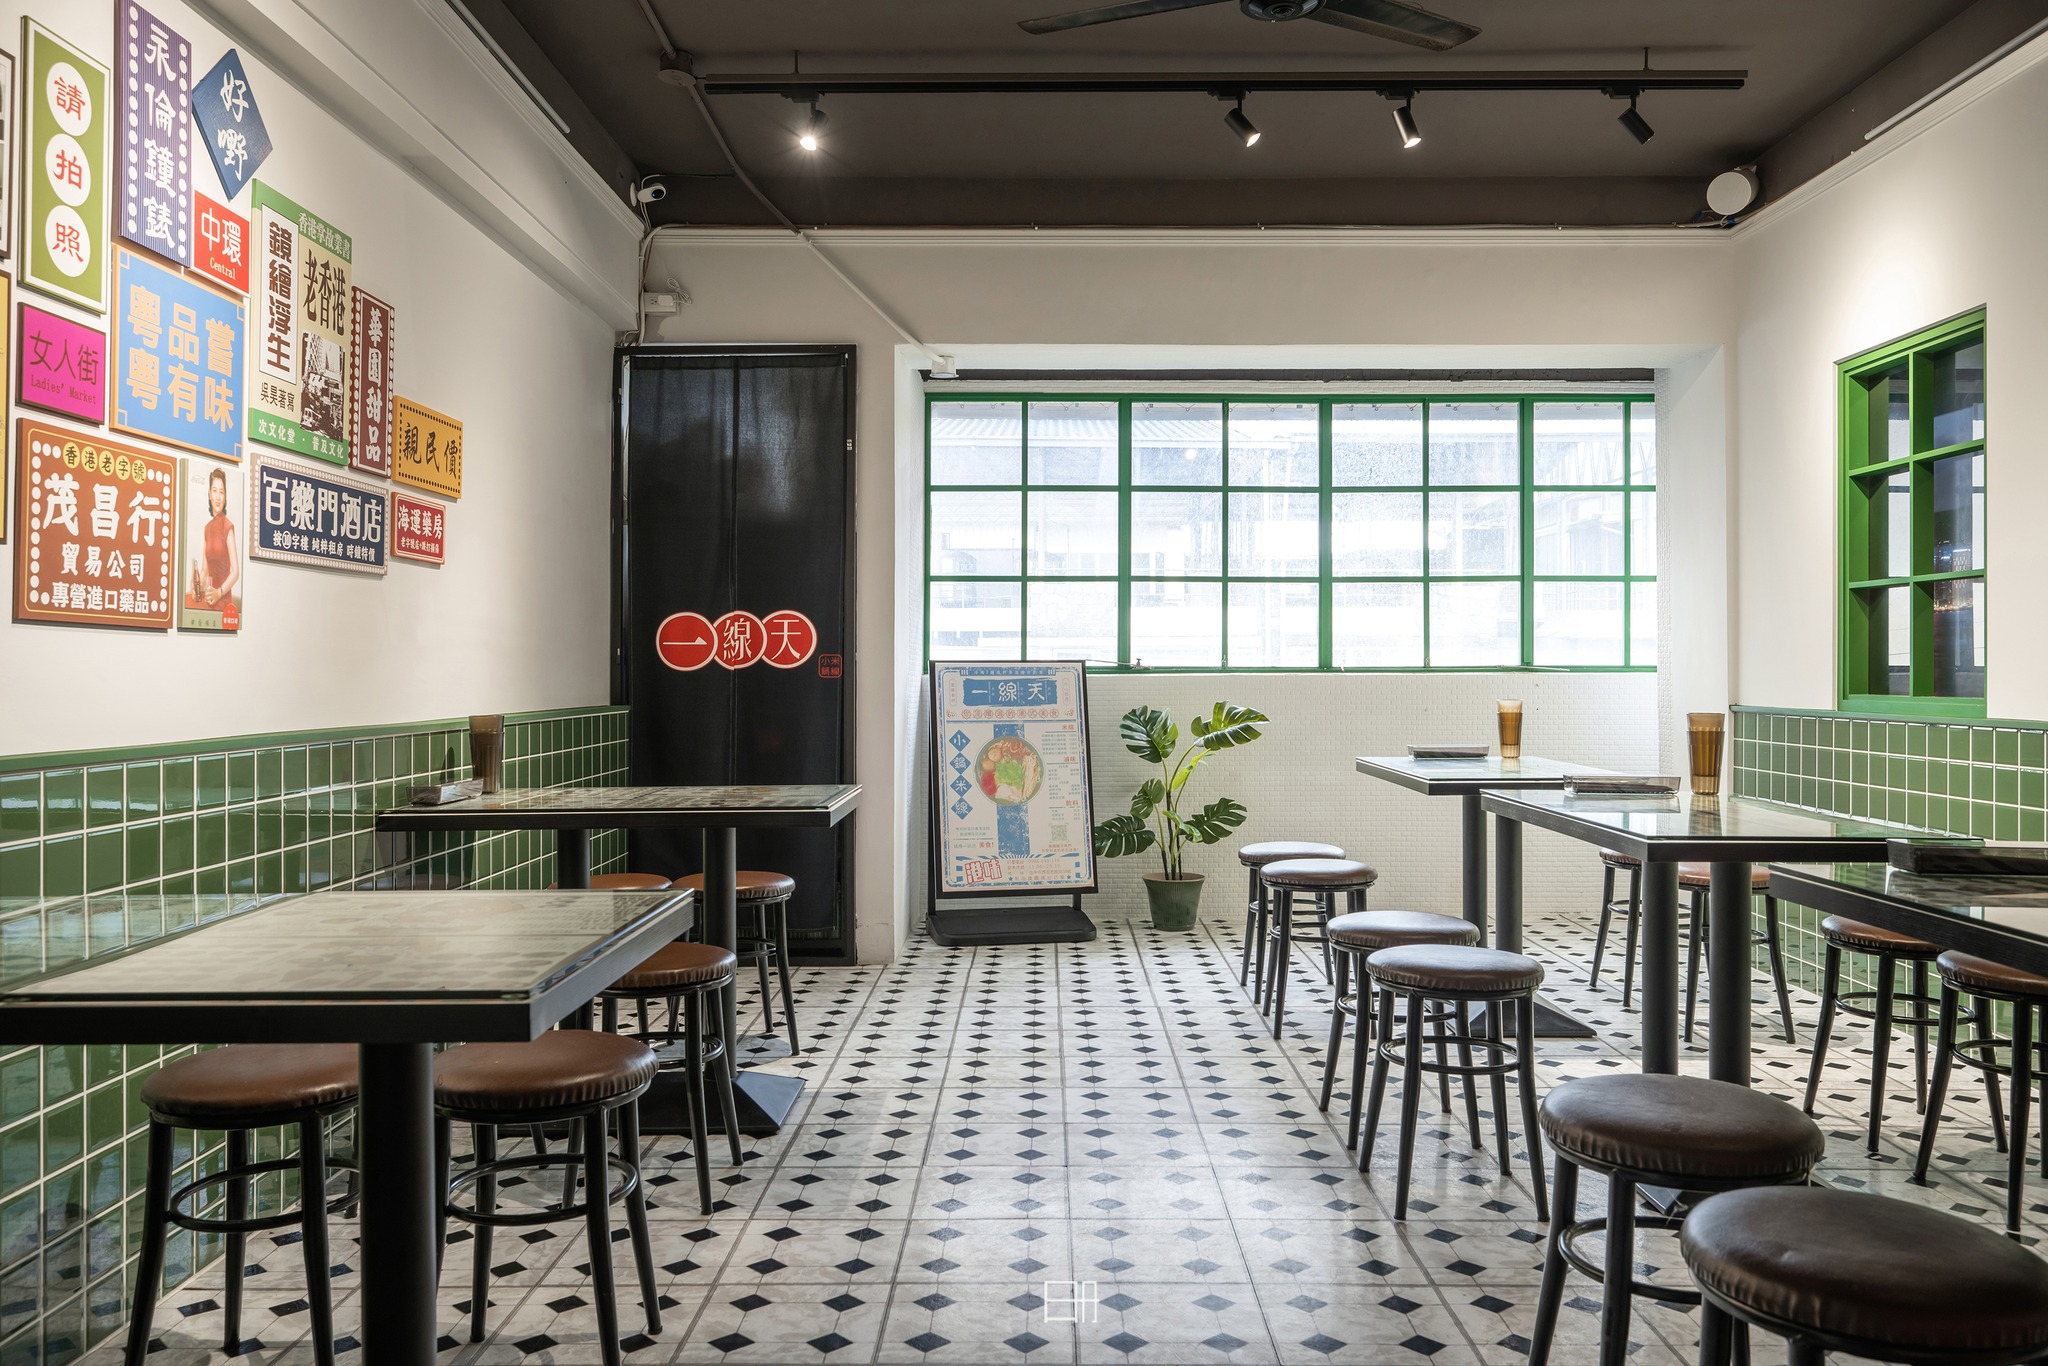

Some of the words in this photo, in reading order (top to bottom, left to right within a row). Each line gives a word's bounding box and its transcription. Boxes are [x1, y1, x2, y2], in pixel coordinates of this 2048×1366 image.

[52, 76, 86, 263] 請拍照
[201, 208, 243, 267] 中環
[209, 257, 237, 281] Central
[303, 248, 345, 336] 老香港
[29, 330, 99, 386] 女人街
[69, 385, 97, 406] Market
[258, 419, 296, 444] 次文化堂
[312, 436, 344, 459] 普及文化
[402, 423, 458, 479] 親民價
[65, 445, 145, 482] 香港老字號
[42, 473, 162, 546] 茂昌行
[263, 471, 382, 543] 百樂門酒店
[61, 542, 146, 582] 貿易公司
[51, 580, 150, 614] 專營進口藥品
[662, 617, 801, 661] 一線天
[971, 682, 1045, 703] 一線天
